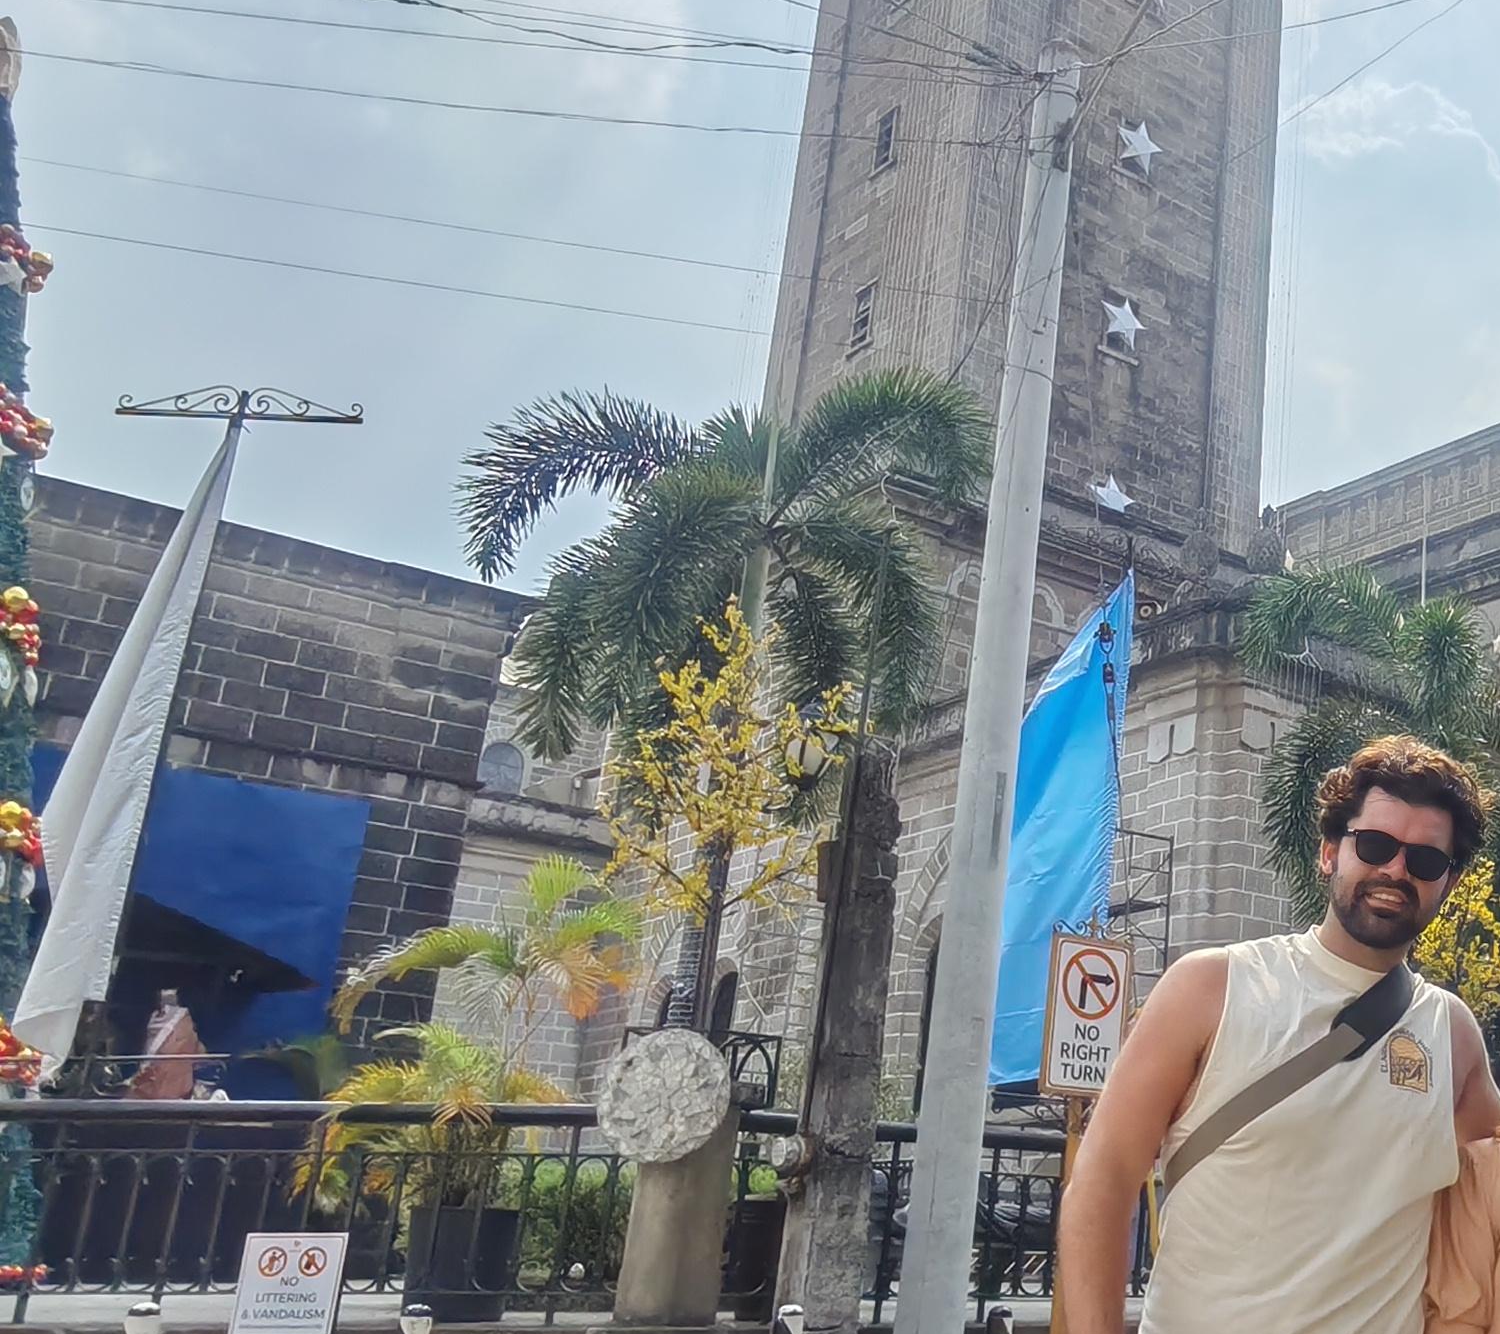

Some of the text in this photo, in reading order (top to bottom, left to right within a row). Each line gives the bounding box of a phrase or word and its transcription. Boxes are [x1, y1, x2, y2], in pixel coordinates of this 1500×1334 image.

[1074, 1022, 1100, 1042] NO
[1060, 1041, 1111, 1063] RIGHT
[1060, 1062, 1106, 1084] TURN
[279, 1275, 300, 1287] NO
[255, 1292, 318, 1304] LITTERING
[240, 1308, 326, 1320] & VANDALISM
